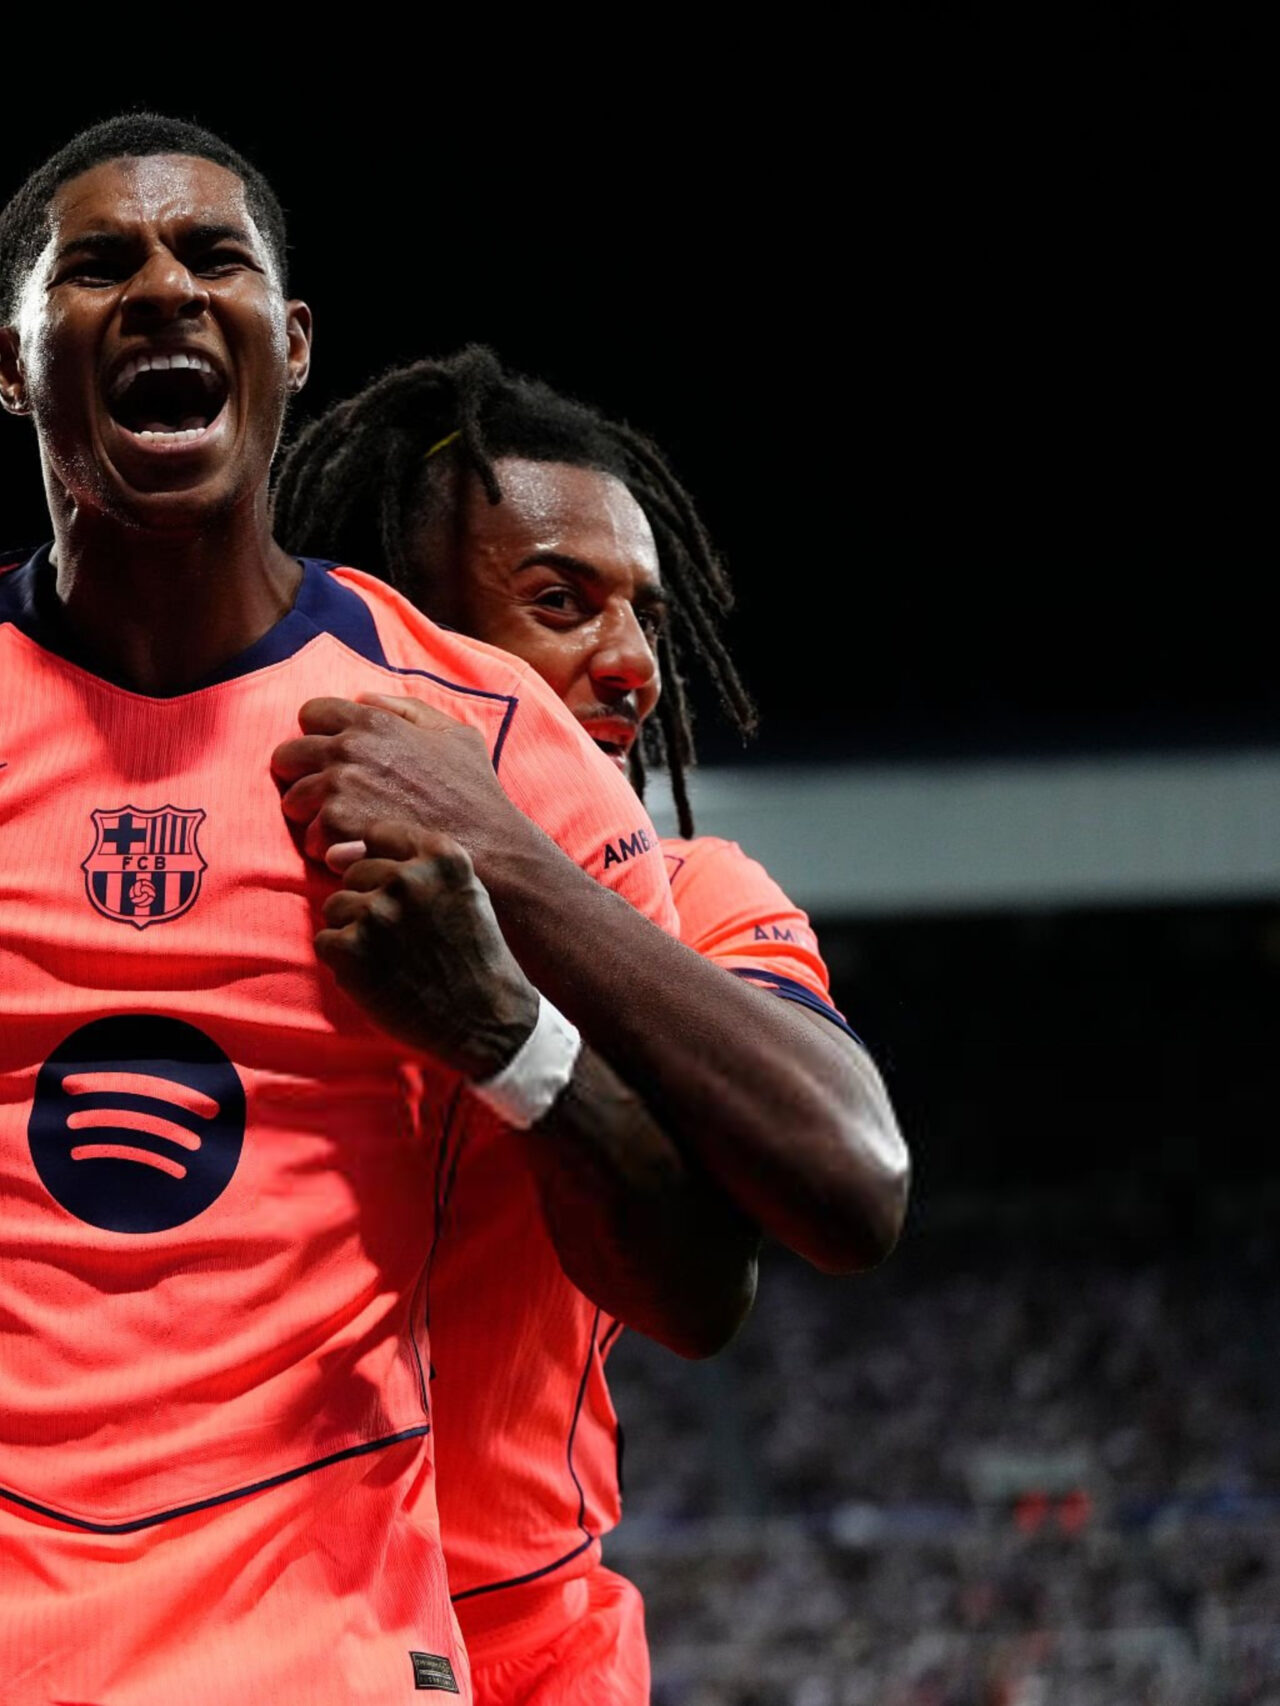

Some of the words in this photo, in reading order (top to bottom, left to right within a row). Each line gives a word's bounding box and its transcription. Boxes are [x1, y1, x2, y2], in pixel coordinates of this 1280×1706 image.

[604, 829, 657, 870] AMB
[122, 856, 166, 871] FCB
[754, 924, 800, 943] AM
